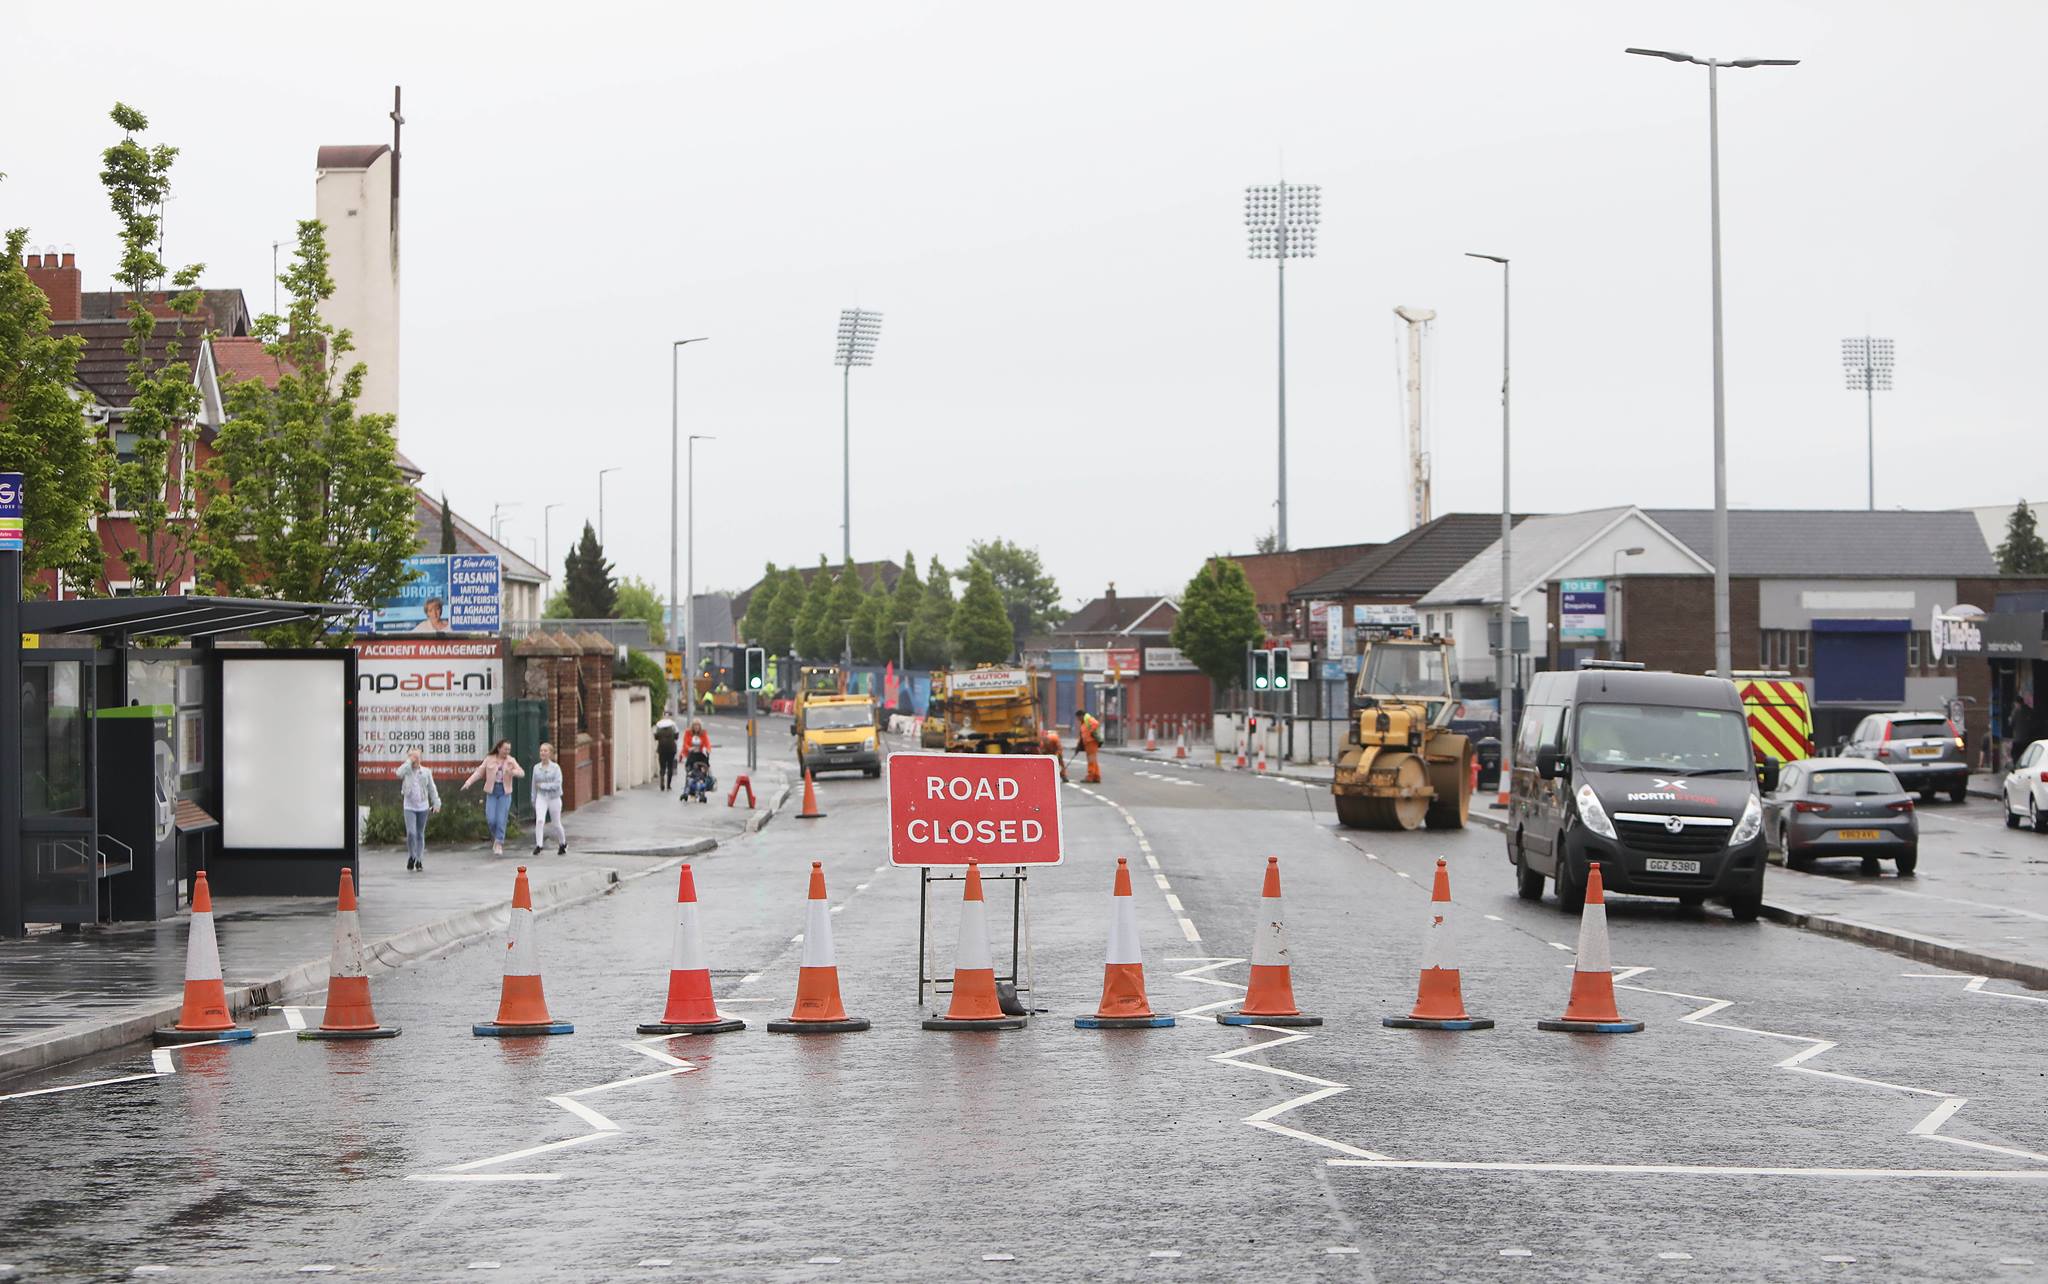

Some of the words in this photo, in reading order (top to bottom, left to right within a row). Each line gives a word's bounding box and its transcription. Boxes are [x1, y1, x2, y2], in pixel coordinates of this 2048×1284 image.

[453, 572, 496, 584] SEASANN
[461, 586, 489, 594] IARTHAR
[1564, 581, 1578, 590] TO
[1580, 581, 1598, 590] LET
[454, 606, 462, 614] IN
[464, 605, 496, 615] AGHAIDH
[365, 645, 416, 655] ACCIDENT
[419, 645, 497, 655] MANAGEMENT
[980, 679, 1023, 687] PAINTING
[365, 731, 385, 740] TEL:
[389, 731, 425, 740] 02890
[429, 731, 450, 740] 388
[454, 731, 475, 740] 388
[429, 744, 450, 753] 388
[454, 744, 475, 753] 388
[927, 777, 1019, 800] ROAD
[907, 819, 1043, 844] CLOSED
[1650, 861, 1669, 870] GGZ
[1672, 862, 1697, 871] 5380
